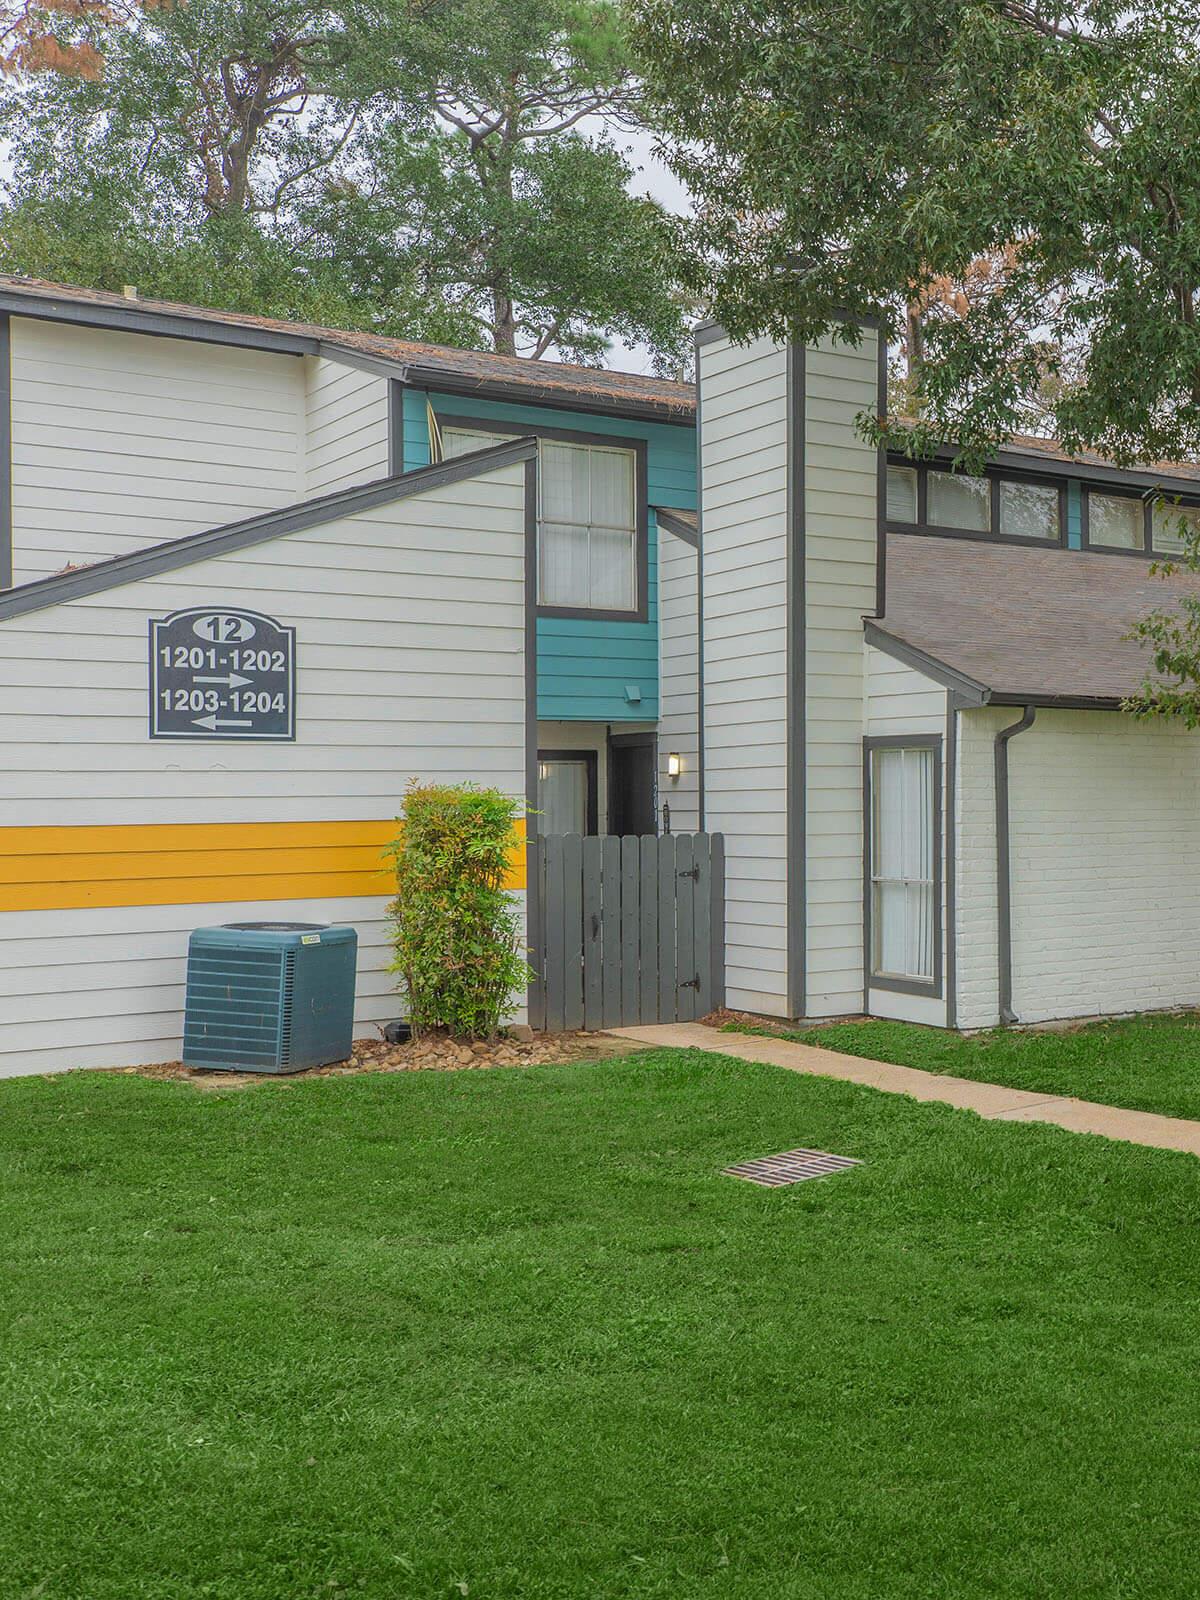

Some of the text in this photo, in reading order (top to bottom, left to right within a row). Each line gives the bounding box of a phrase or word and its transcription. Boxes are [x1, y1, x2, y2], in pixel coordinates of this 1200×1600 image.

[207, 617, 242, 642] 12
[160, 646, 286, 672] 1201-1202
[160, 689, 286, 713] 1203-1204
